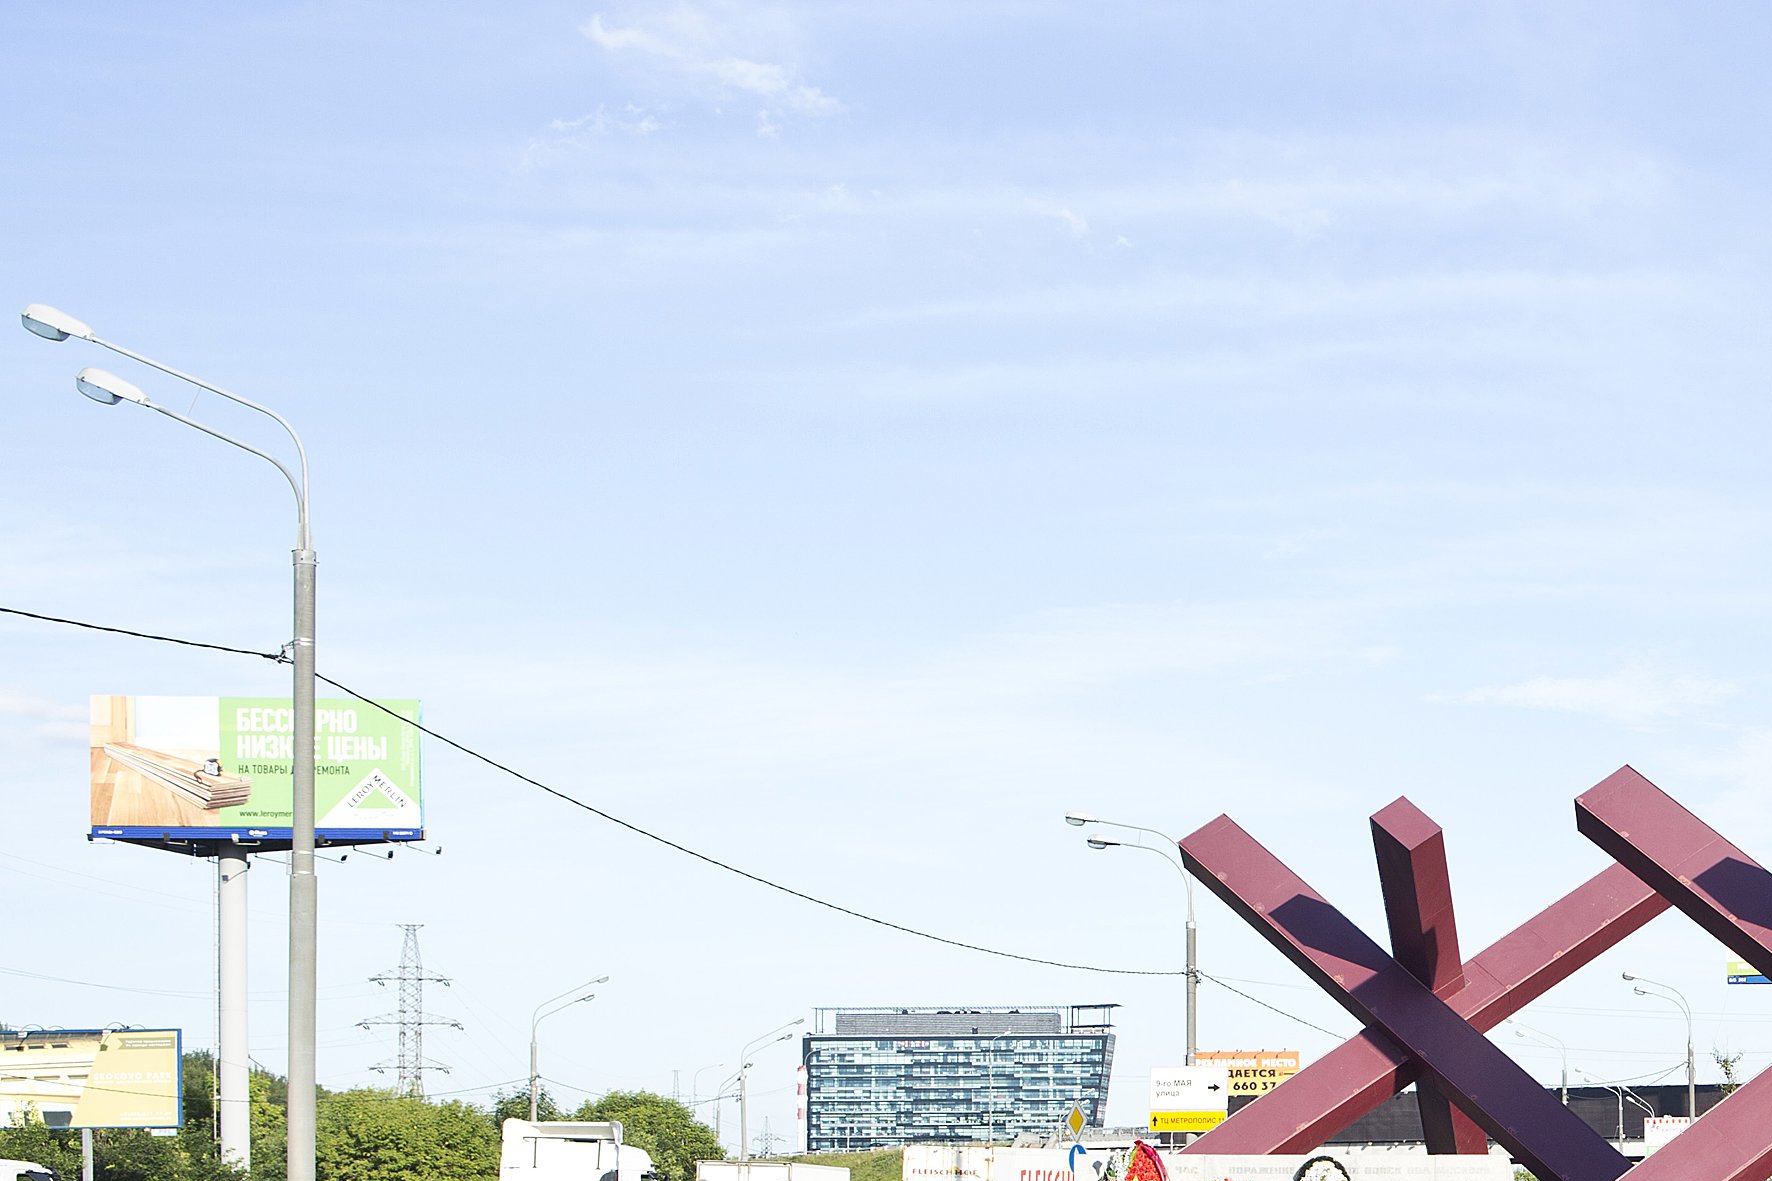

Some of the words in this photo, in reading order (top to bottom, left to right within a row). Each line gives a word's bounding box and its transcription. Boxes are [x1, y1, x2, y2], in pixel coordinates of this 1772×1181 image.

[236, 708, 357, 733] БЕССРНО
[236, 735, 321, 759] НИЗКЕ
[327, 736, 387, 762] ЦЕНЫ
[238, 765, 249, 774] НА
[252, 765, 288, 775] ТОВАРЫ
[347, 781, 374, 808] LEROY
[373, 774, 407, 808] MERLIN
[239, 810, 293, 819] www.leroymer
[1262, 1058, 1297, 1067] МЕСТО
[1228, 1069, 1276, 1079] ДАЕТСЯ
[1156, 1080, 1172, 1088] 9-го
[1233, 1082, 1257, 1091] 660
[1262, 1082, 1277, 1090] 37
